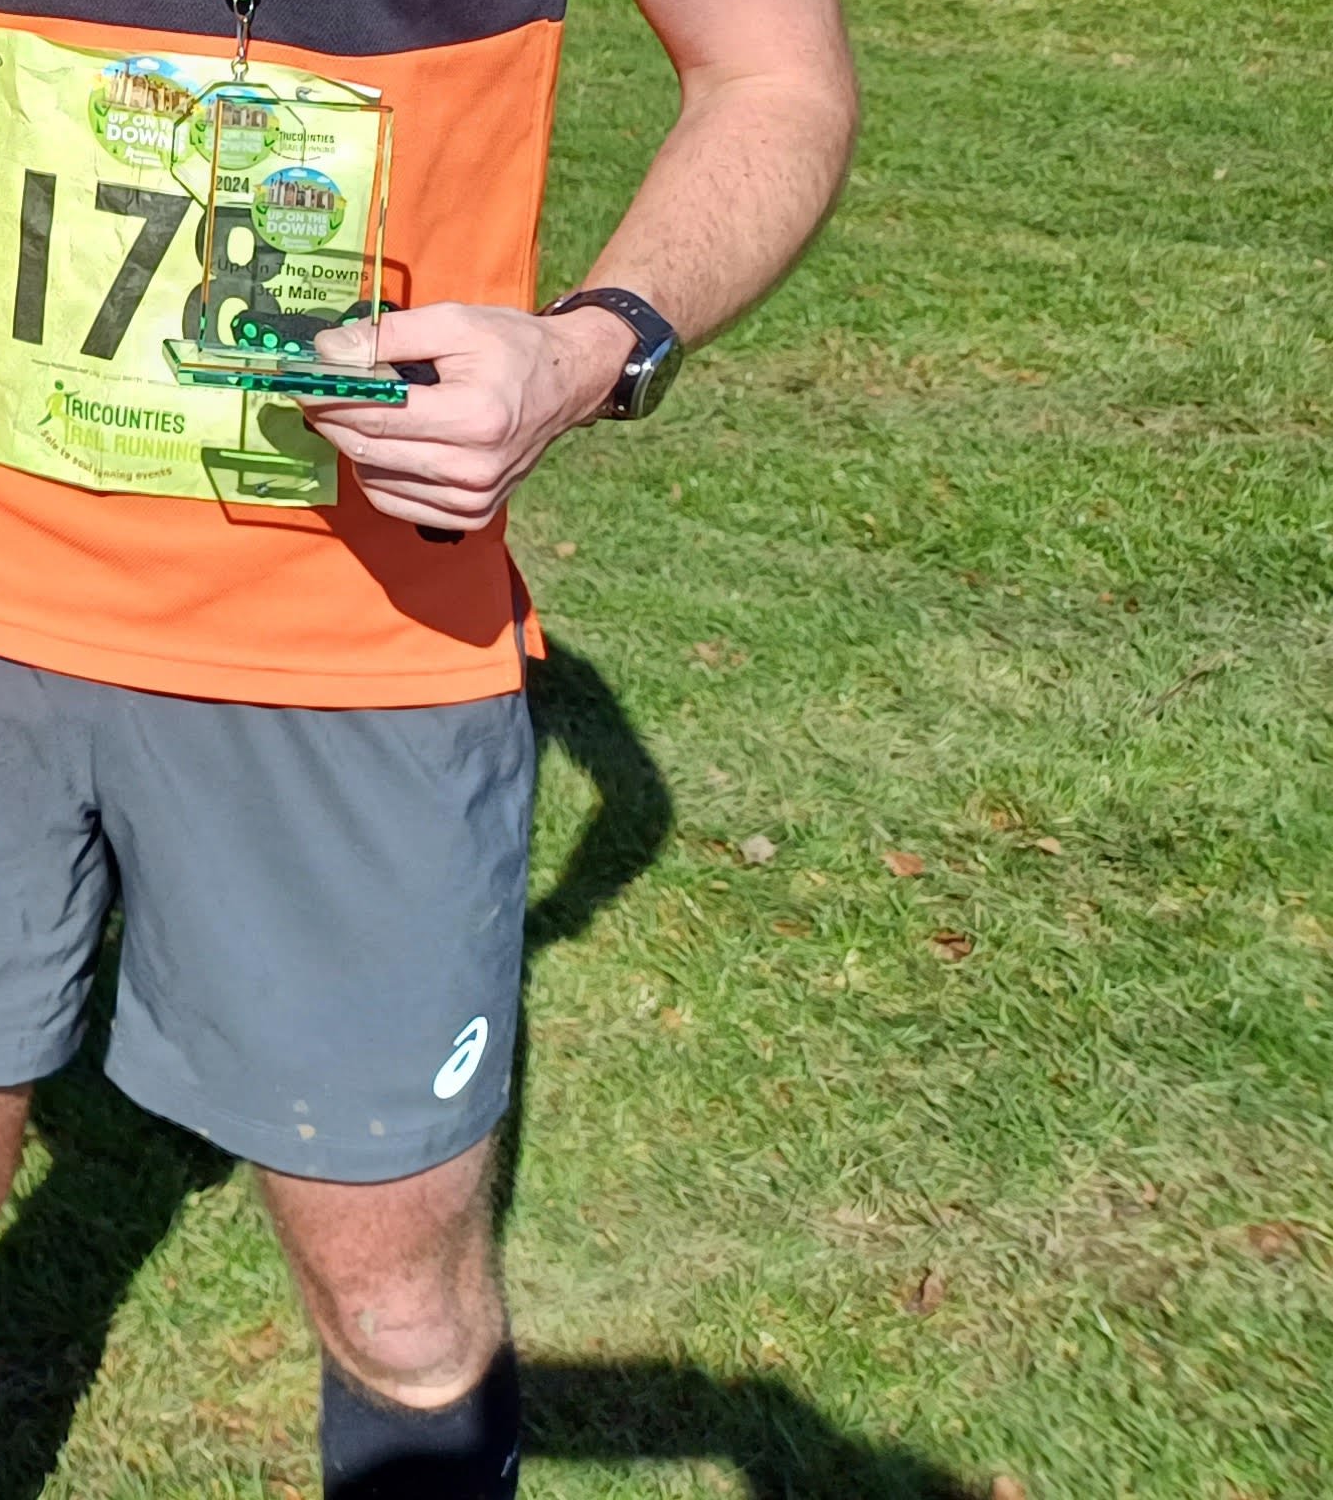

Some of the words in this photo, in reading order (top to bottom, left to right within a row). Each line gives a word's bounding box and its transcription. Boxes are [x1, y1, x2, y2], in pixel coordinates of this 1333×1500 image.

[108, 112, 129, 125] UP
[215, 175, 250, 194] 2024
[266, 220, 327, 237] DOWNS
[13, 168, 286, 361] 178
[276, 261, 307, 277] The
[312, 264, 369, 282] Downs
[257, 284, 283, 298] 3rd
[288, 285, 328, 302] Male
[64, 391, 186, 435] TRICOUNTIES
[113, 431, 201, 464] RUNNING
